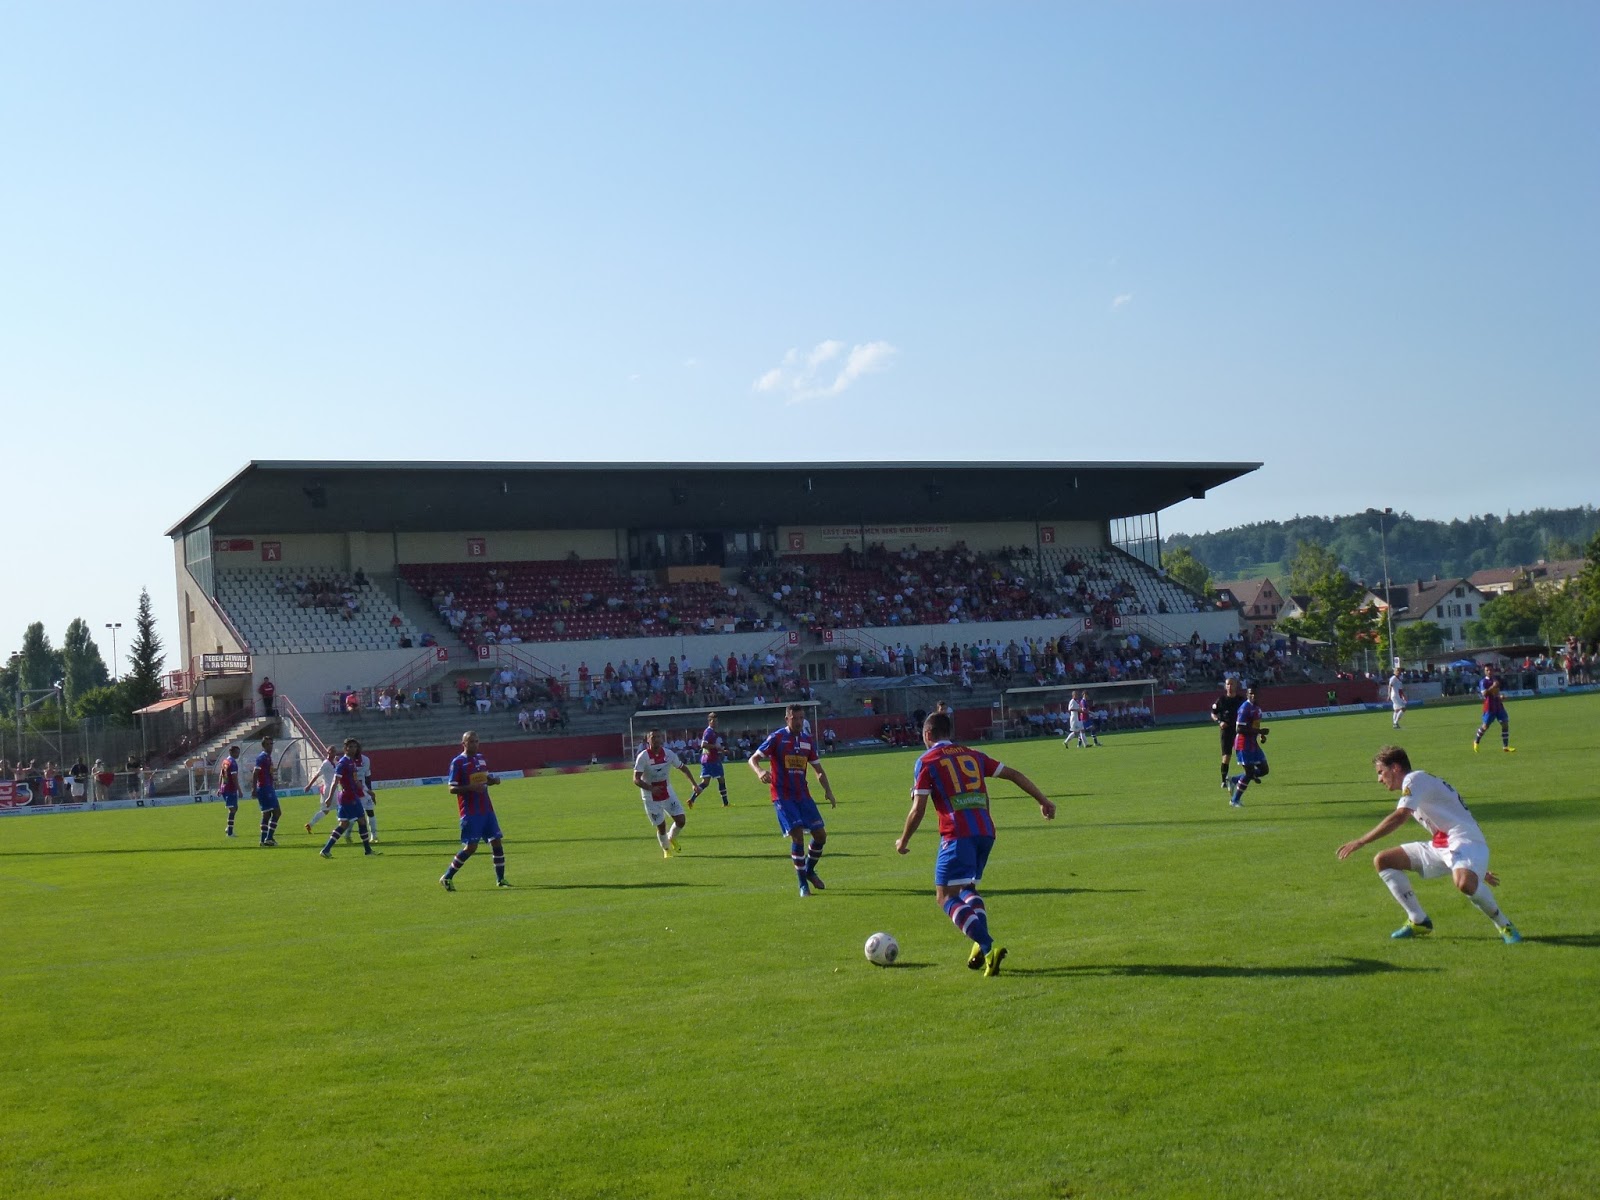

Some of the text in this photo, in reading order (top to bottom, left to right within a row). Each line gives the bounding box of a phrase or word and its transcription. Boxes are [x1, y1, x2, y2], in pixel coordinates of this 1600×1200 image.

[1045, 533, 1051, 542] D
[793, 539, 800, 548] C
[268, 549, 276, 559] A
[473, 545, 481, 555] B
[825, 631, 831, 639] C
[481, 647, 487, 655] B
[940, 755, 981, 793] 19
